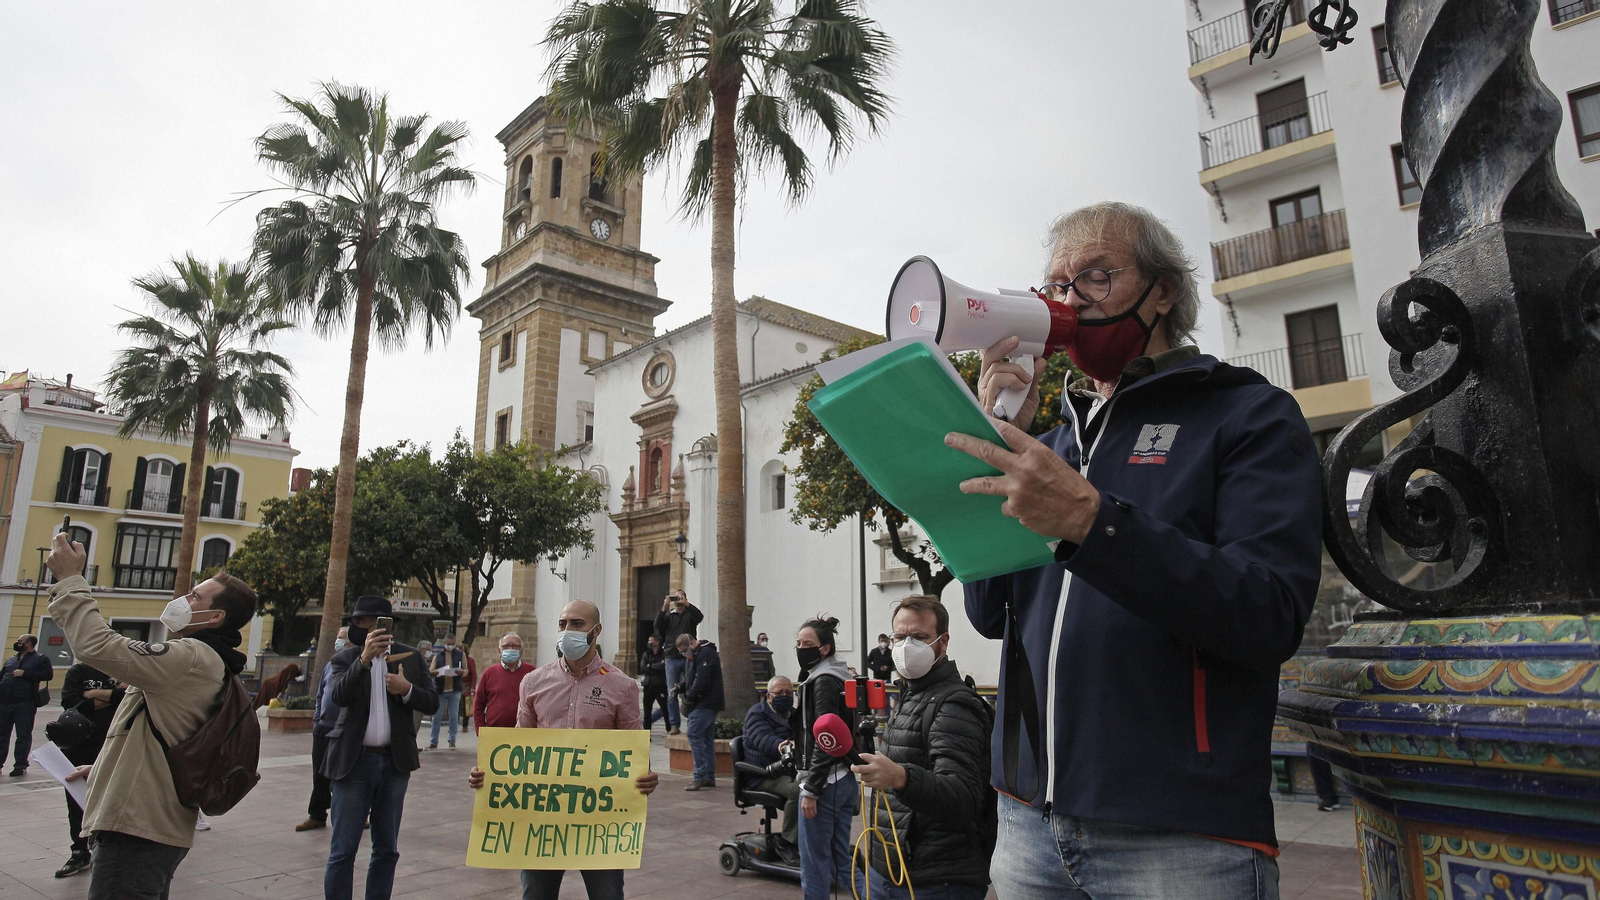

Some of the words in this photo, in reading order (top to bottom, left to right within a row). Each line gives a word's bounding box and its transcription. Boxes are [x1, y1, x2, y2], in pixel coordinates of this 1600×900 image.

[822, 736, 831, 746] 8
[489, 743, 589, 777] COMITÉ
[599, 750, 633, 778] DE
[489, 782, 629, 814] EXPERTOS...
[481, 821, 515, 854] EN
[524, 821, 643, 858] MENTIRAS!!
